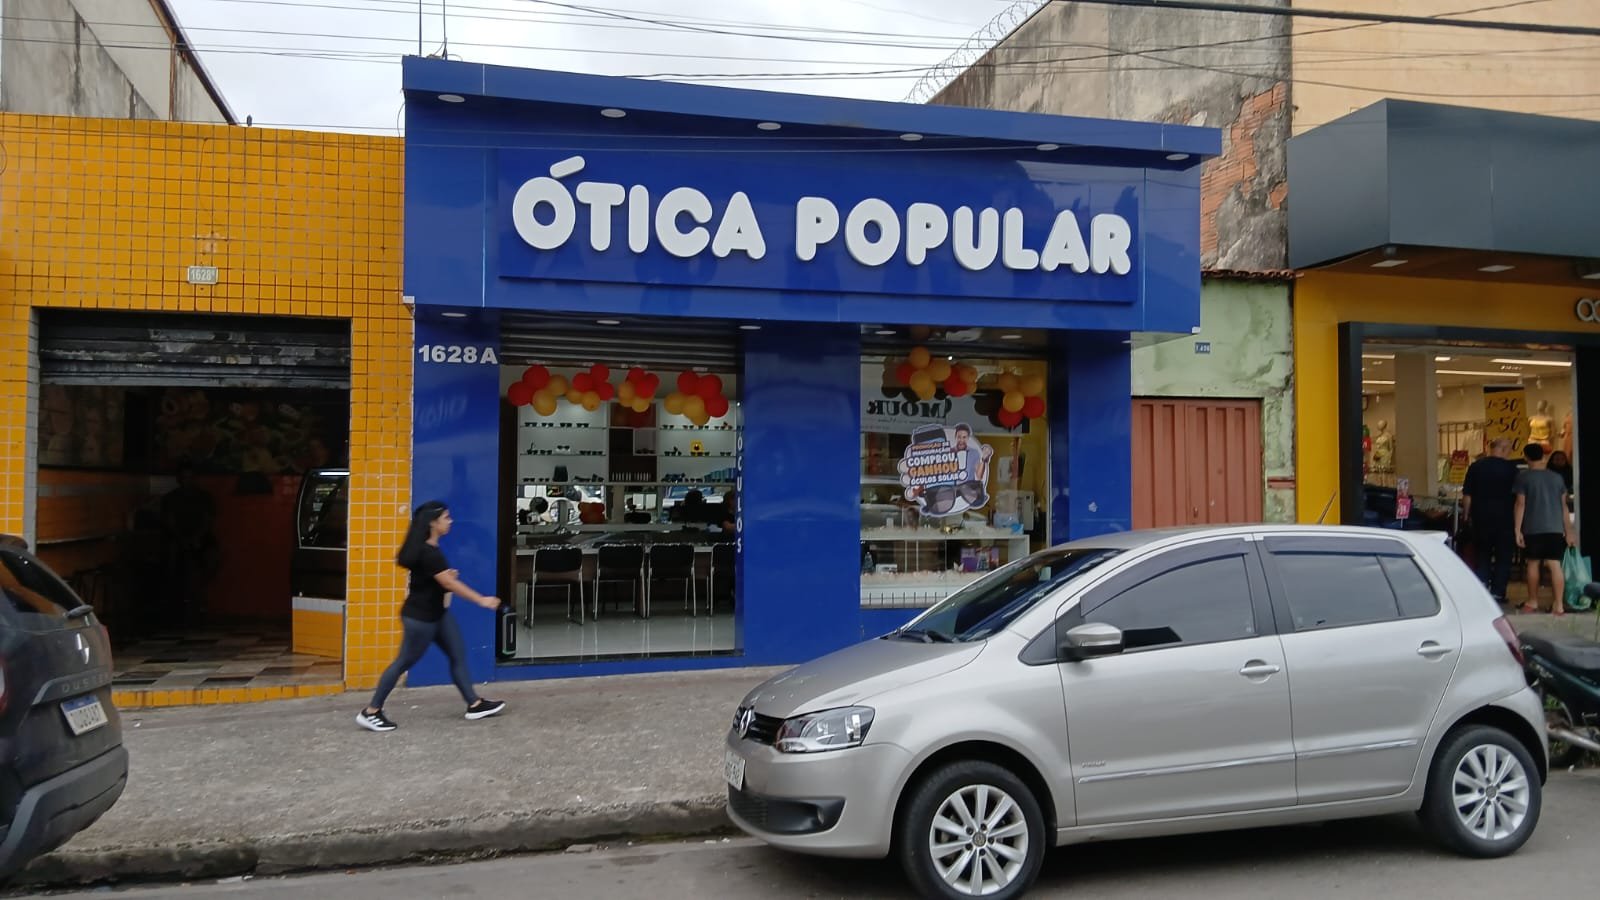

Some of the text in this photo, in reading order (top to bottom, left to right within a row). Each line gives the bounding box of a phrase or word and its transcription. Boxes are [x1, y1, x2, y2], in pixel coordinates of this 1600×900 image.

[512, 155, 1131, 275] ÓTICA POPULAR
[418, 344, 498, 365] 1628A
